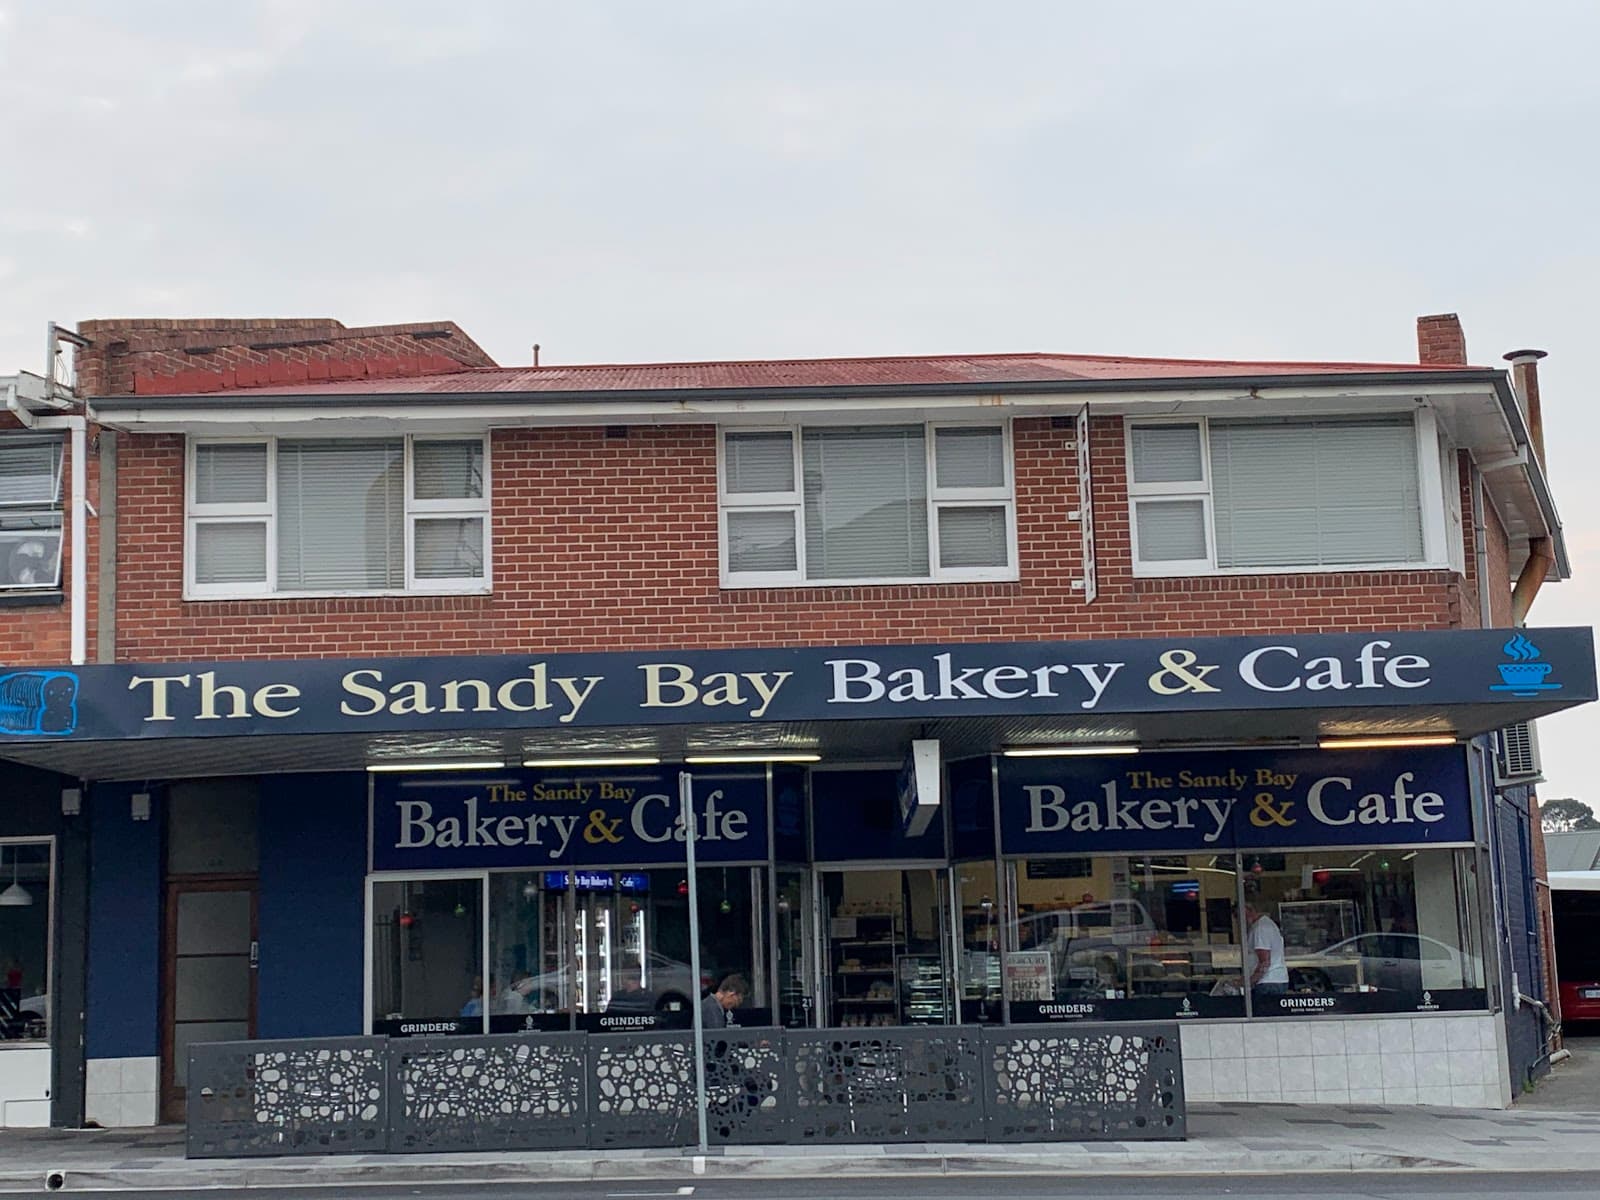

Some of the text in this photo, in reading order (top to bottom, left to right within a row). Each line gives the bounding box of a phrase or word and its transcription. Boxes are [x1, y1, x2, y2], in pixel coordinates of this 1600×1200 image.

[128, 640, 1431, 724] The Sandy Bay Bakery & Cafe
[1127, 768, 1298, 792] The Sandy Bay
[487, 781, 636, 804] The Sandy Bay
[1023, 772, 1445, 842] Bakery & Cafe
[395, 790, 748, 859] Bakery & Cafe
[1038, 1003, 1094, 1015] GRINDERS
[1279, 997, 1335, 1008] GRINDERS
[400, 1022, 457, 1033] GRINDERS
[600, 1015, 655, 1027] GRINDERS
